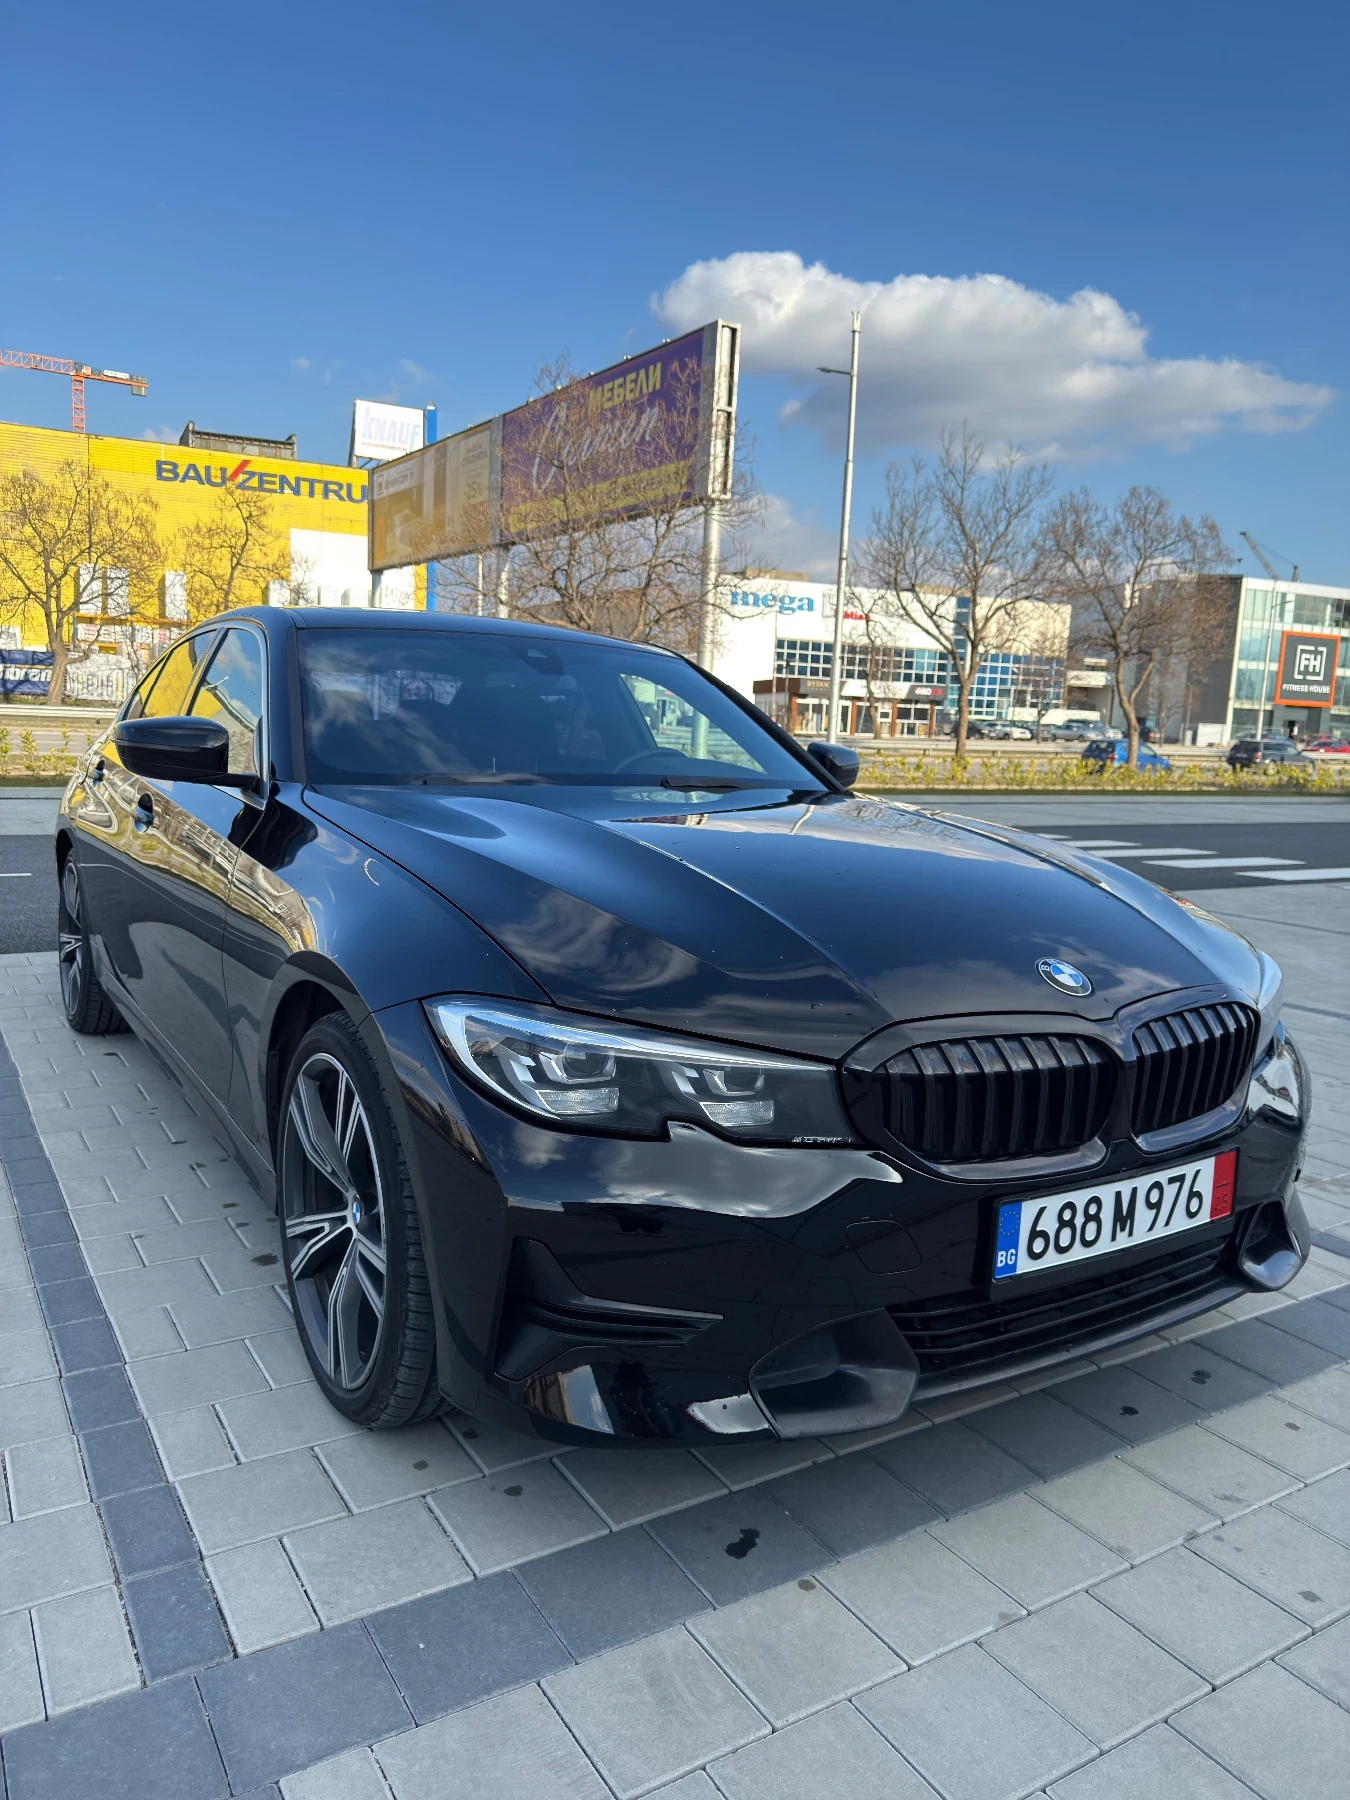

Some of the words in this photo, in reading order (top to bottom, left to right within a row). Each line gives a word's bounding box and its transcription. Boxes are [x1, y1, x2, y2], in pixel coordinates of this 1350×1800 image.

[730, 591, 815, 615] mega
[1300, 653, 1321, 672] FH
[1282, 684, 1308, 692] FITNESS
[1310, 685, 1331, 694] HOUSE
[997, 1249, 1016, 1267] BG
